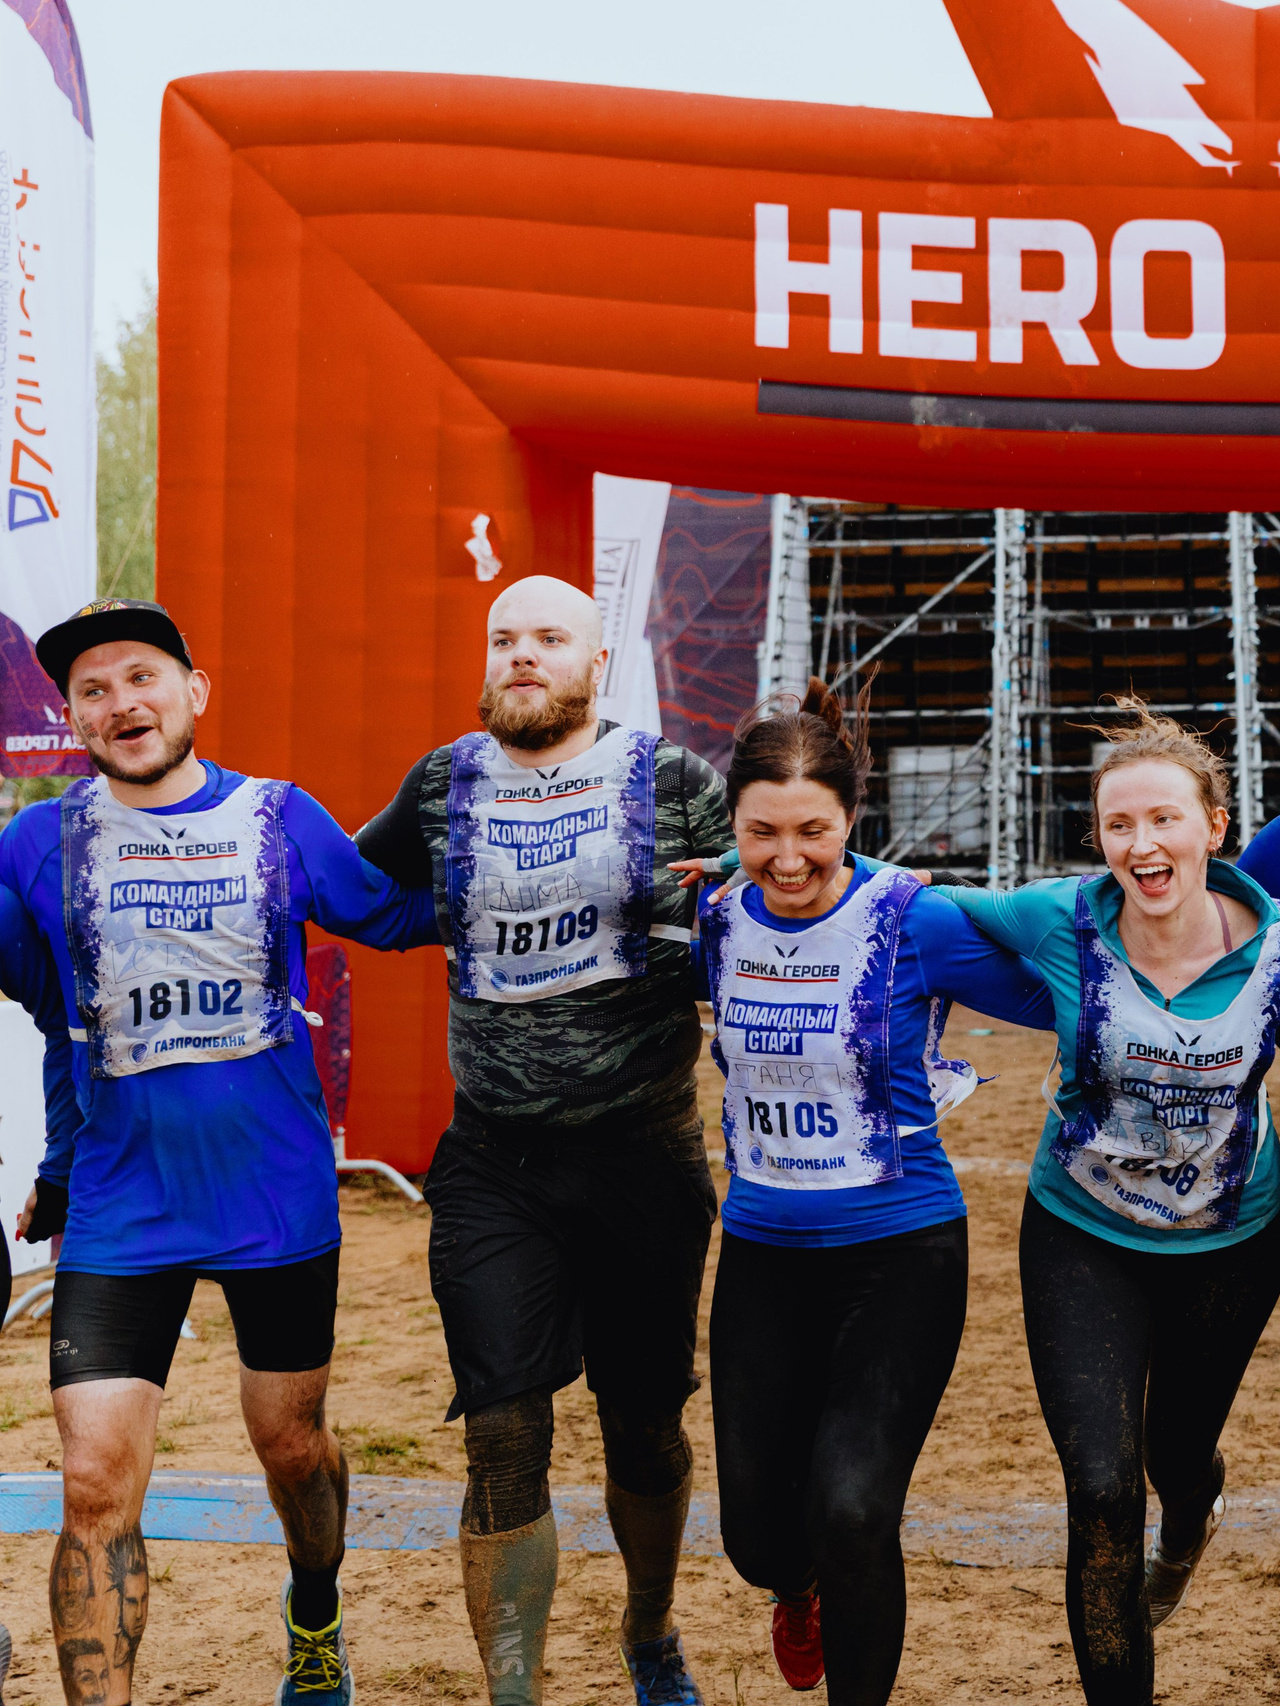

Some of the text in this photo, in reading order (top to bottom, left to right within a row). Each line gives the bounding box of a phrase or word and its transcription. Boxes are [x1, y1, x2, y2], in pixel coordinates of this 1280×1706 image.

[754, 202, 1226, 370] HERO
[495, 776, 604, 799] ГОНКА ГЕРОЕВ
[490, 807, 605, 845] КОМАНДНЫЙ
[118, 841, 237, 857] ГОНКА ГЕРОЕВ
[520, 839, 573, 868] СТАРТ
[113, 876, 244, 908] КОМАНДНЫЙ
[489, 873, 583, 916] ДИМА
[149, 907, 211, 929] СТАРТ
[495, 904, 598, 956] 18109
[132, 943, 222, 973] СТАС
[515, 955, 598, 987] ГАЗПРОМБАНК
[736, 958, 840, 978] ГОНКА ГЕРОЕВ
[128, 978, 243, 1027] 18102
[726, 1001, 837, 1031] КОМАНДНЫЙ
[154, 1035, 246, 1053] ГАЗПРОМБАНК
[748, 1030, 800, 1053] СТАРТ
[1127, 1042, 1243, 1067] ГОНКА ГЕРОЕВ
[734, 1063, 818, 1090] ТАНЯ
[744, 1096, 839, 1138] 18105
[1156, 1104, 1205, 1128] СТАРТ
[767, 1155, 847, 1171] ГАЗПРОМБАНК
